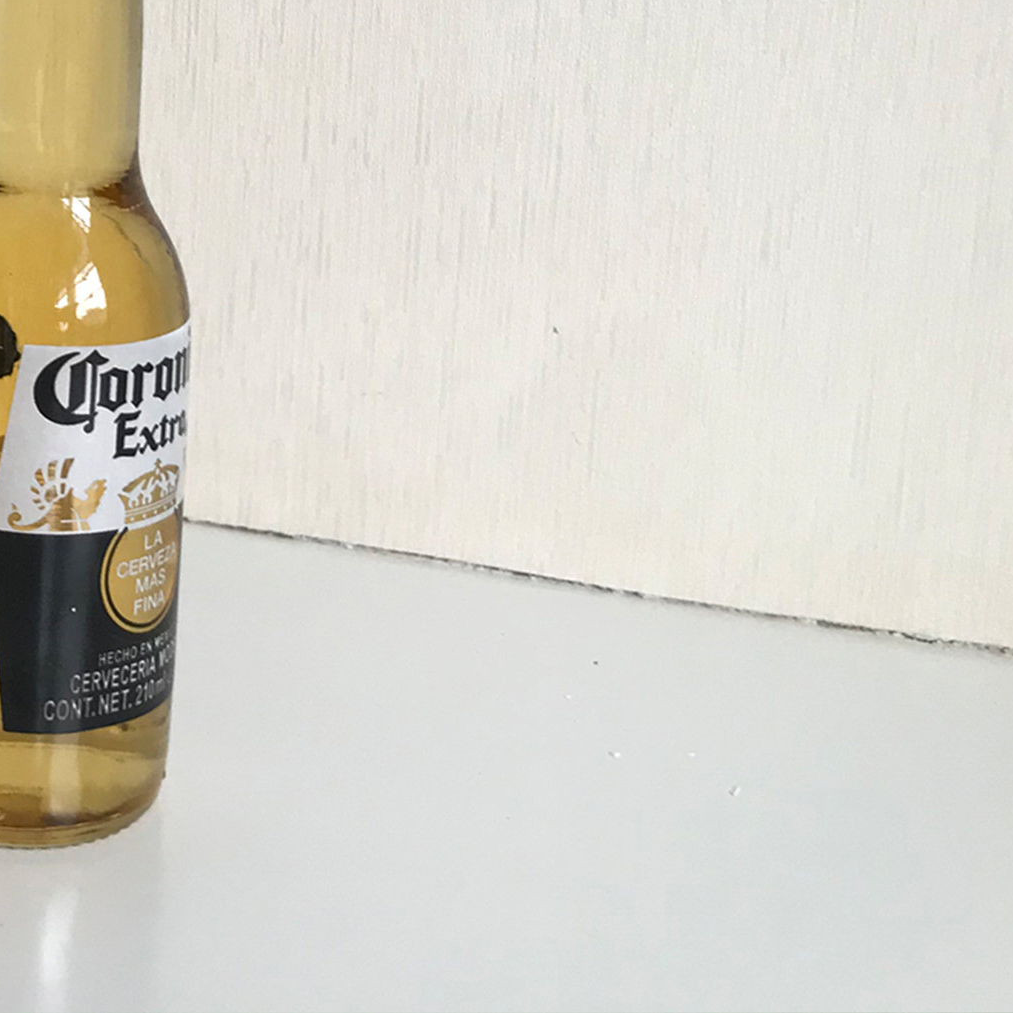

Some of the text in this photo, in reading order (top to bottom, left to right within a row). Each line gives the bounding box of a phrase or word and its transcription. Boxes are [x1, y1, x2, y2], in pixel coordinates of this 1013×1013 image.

[33, 347, 189, 434] Coron
[144, 529, 163, 550] LA
[135, 568, 166, 593] MAS
[133, 590, 165, 616] FINA
[98, 645, 138, 667] HECHO
[70, 655, 156, 694] CERVECERIA
